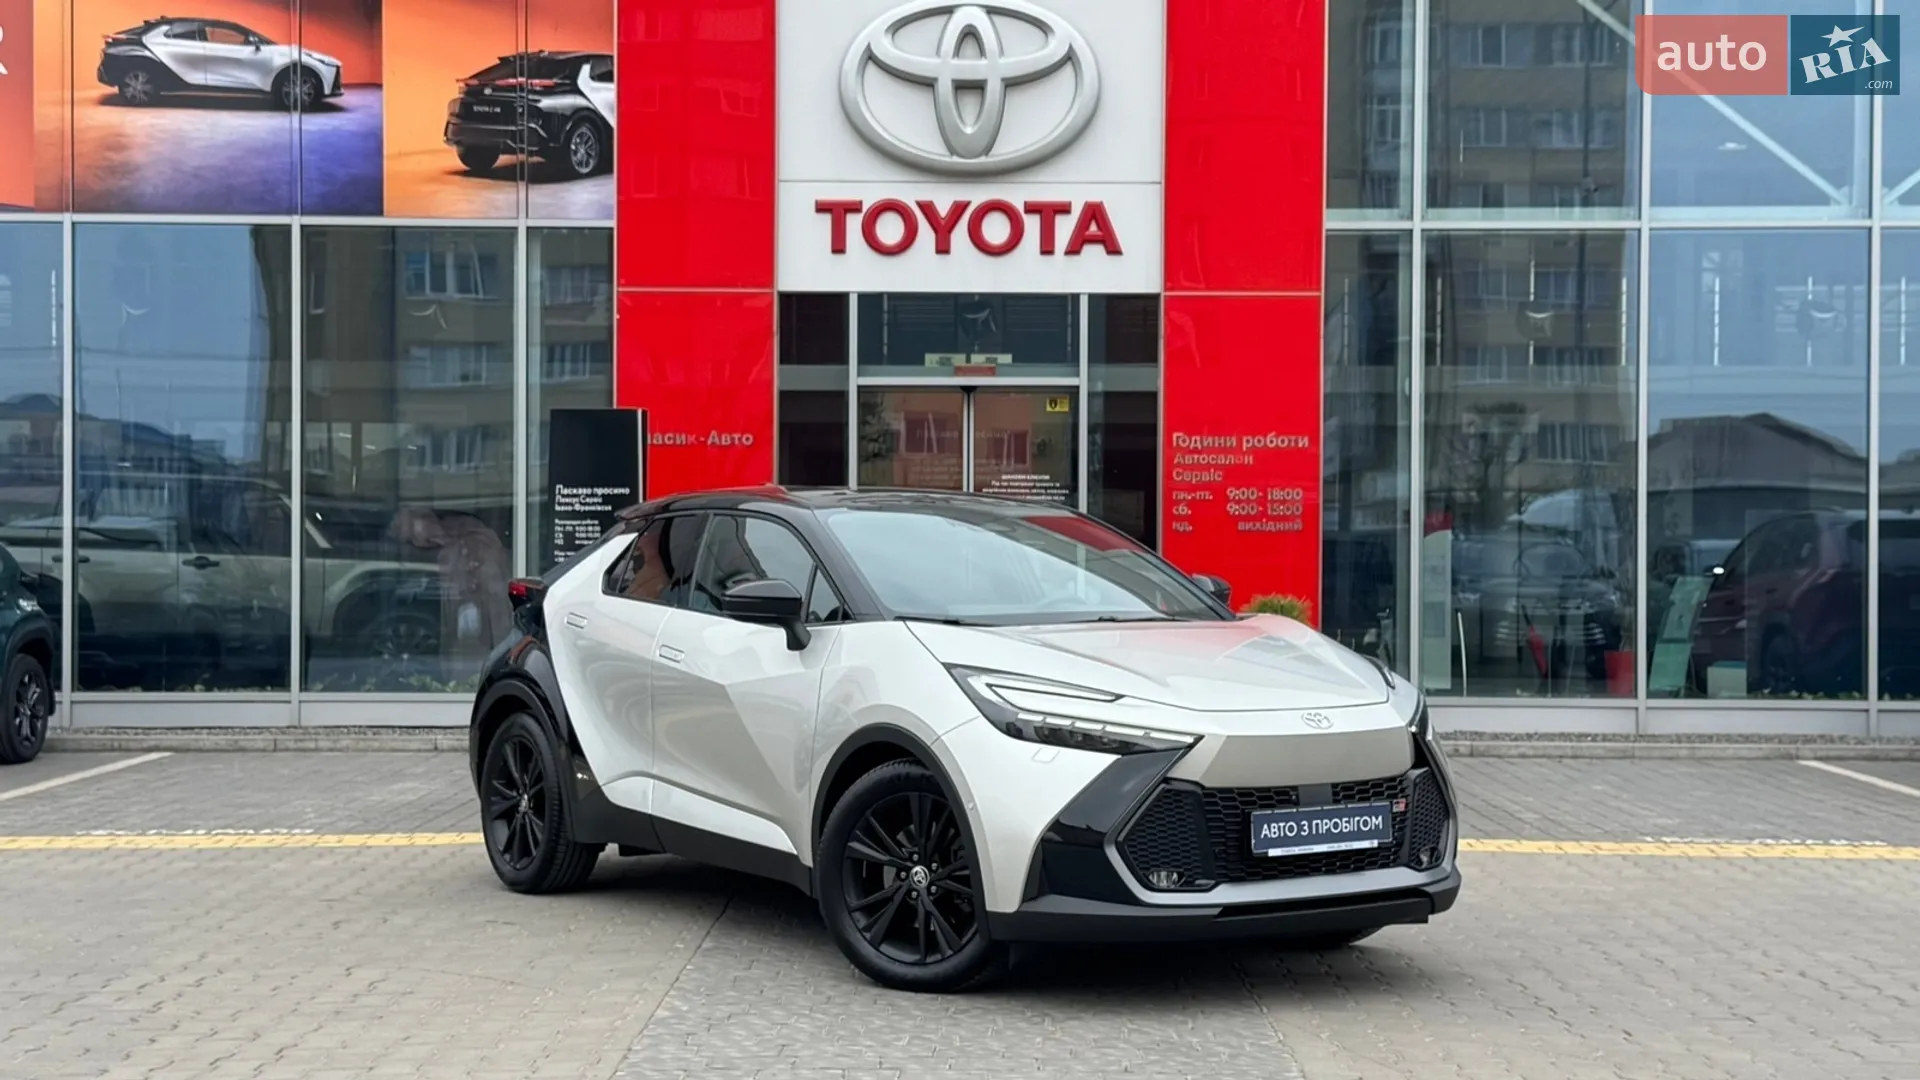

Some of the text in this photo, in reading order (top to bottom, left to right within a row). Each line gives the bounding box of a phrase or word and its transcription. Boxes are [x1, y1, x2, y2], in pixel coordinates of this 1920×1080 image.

[815, 198, 1124, 257] TOYOTA
[1172, 432, 1309, 451] Години роботи
[1173, 453, 1253, 465] Автосалон
[1172, 468, 1223, 483] Сервіс
[1260, 815, 1383, 839] АВТО З ПРОБІГОМ
